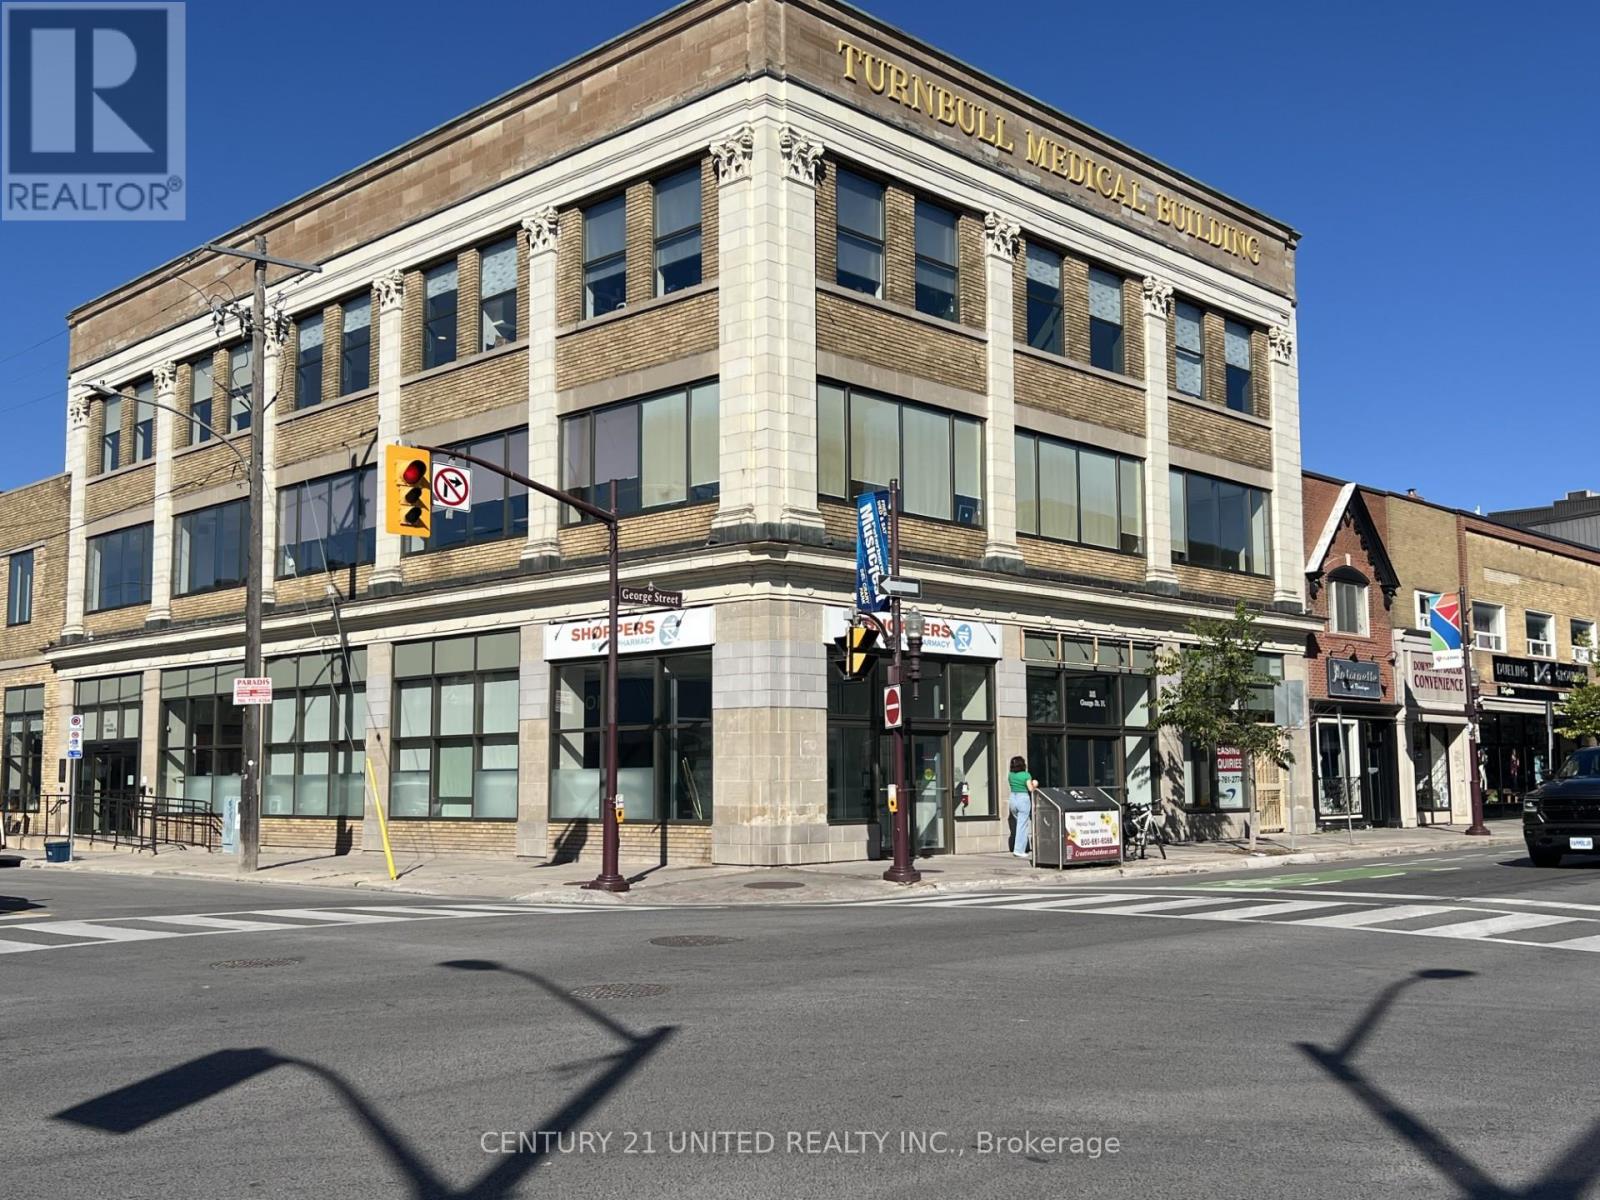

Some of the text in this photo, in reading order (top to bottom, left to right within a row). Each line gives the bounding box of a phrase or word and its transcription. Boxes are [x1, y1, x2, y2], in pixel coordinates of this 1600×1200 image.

[838, 39, 1261, 265] TURNBULL MEDICAL BUILDING
[621, 588, 679, 605] George Street
[1496, 663, 1529, 677] DUELING
[1414, 674, 1464, 691] CONVENIENCE
